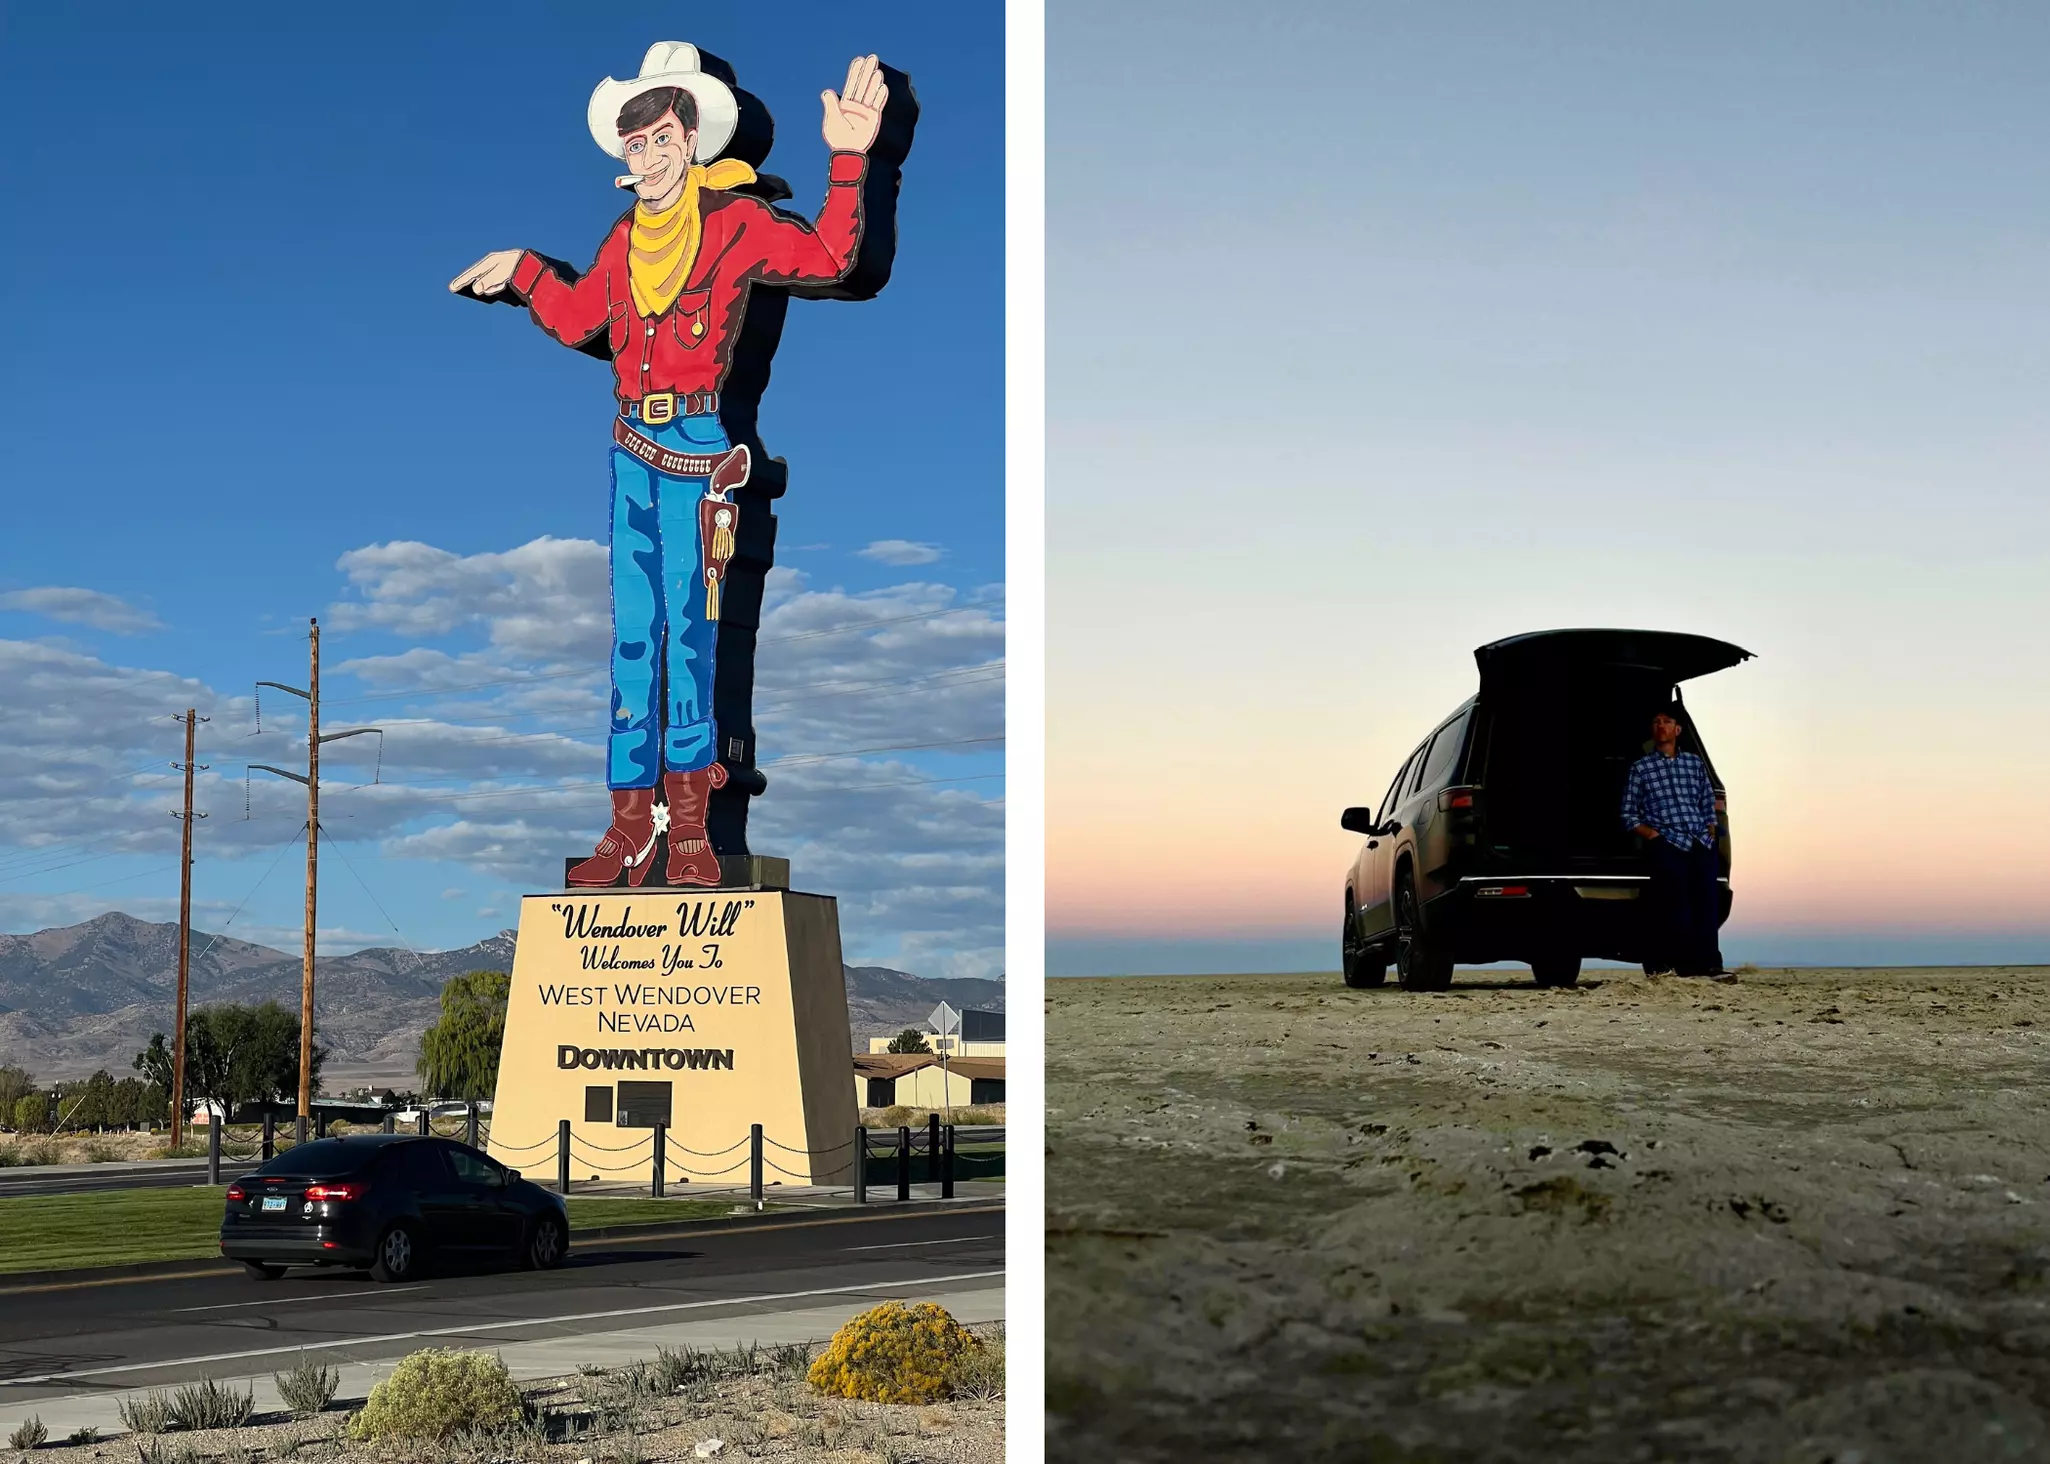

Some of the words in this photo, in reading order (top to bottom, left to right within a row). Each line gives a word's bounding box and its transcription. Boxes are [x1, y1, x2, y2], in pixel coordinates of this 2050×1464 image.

[580, 945, 655, 970] Welcomes
[661, 944, 694, 977] You
[698, 944, 723, 969] To
[538, 984, 608, 1005] WEST
[614, 984, 761, 1005] WENDOVER
[598, 1012, 696, 1033] NEVADA
[557, 1045, 735, 1070] DOWNTOWN
